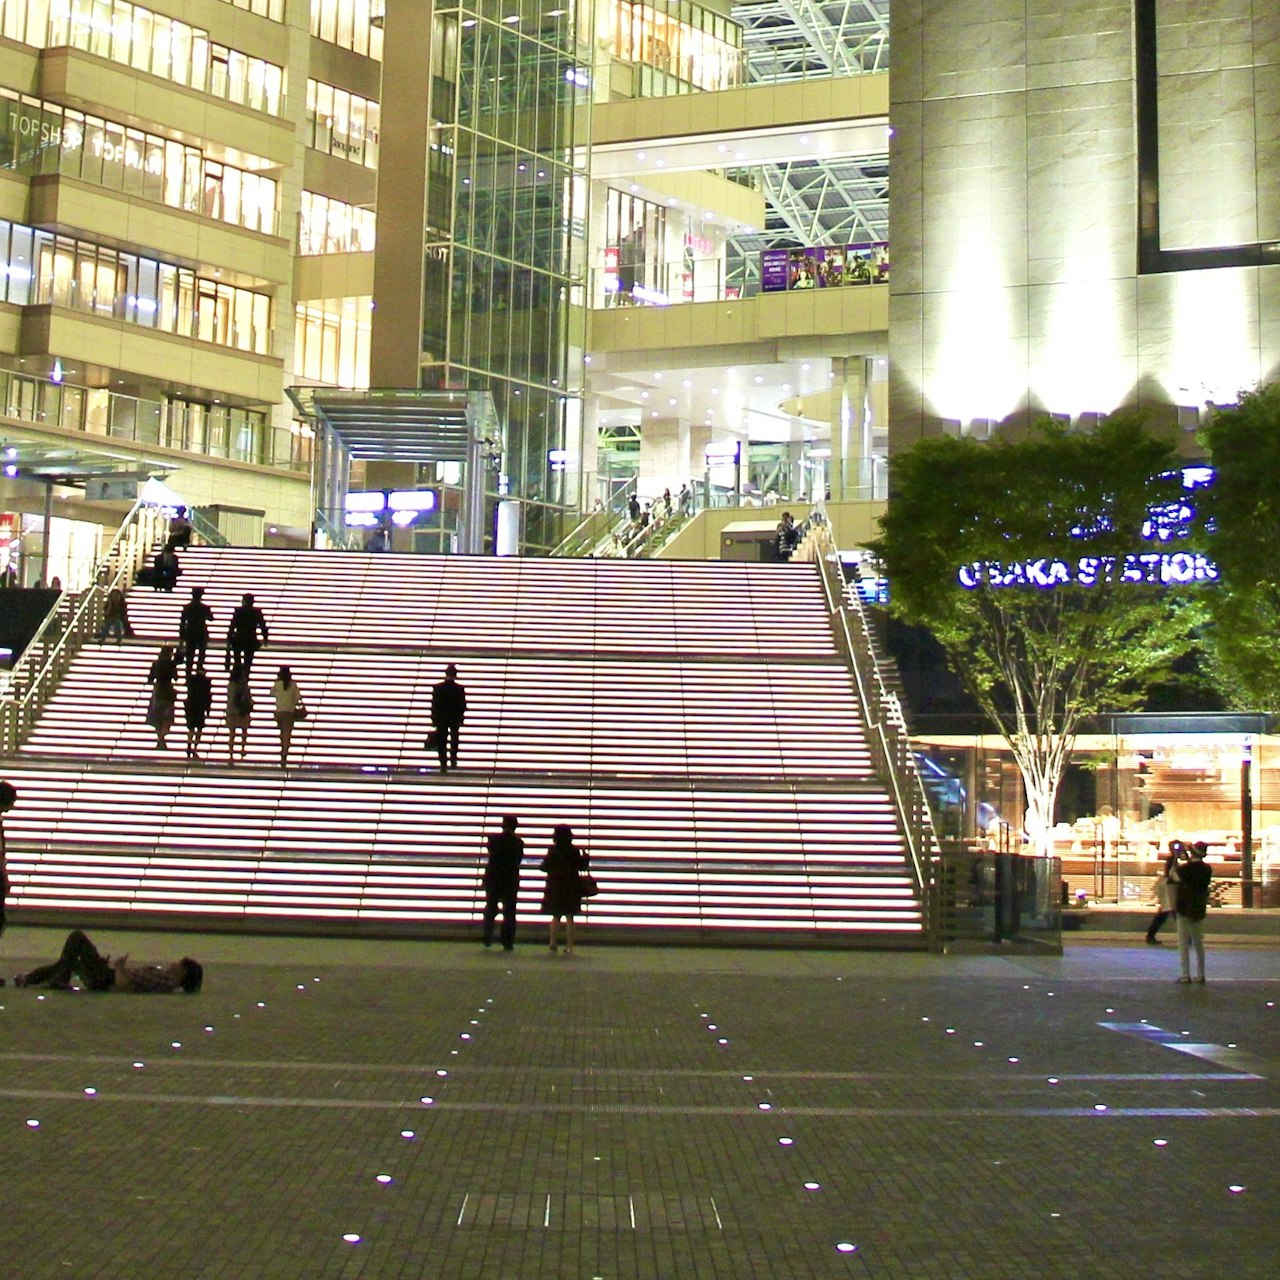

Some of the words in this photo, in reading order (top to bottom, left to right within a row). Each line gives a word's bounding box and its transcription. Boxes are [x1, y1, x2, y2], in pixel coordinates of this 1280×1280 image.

[9, 111, 83, 151] TOPSHOP
[958, 558, 1070, 589] OSAKA
[1076, 553, 1219, 586] STATION
